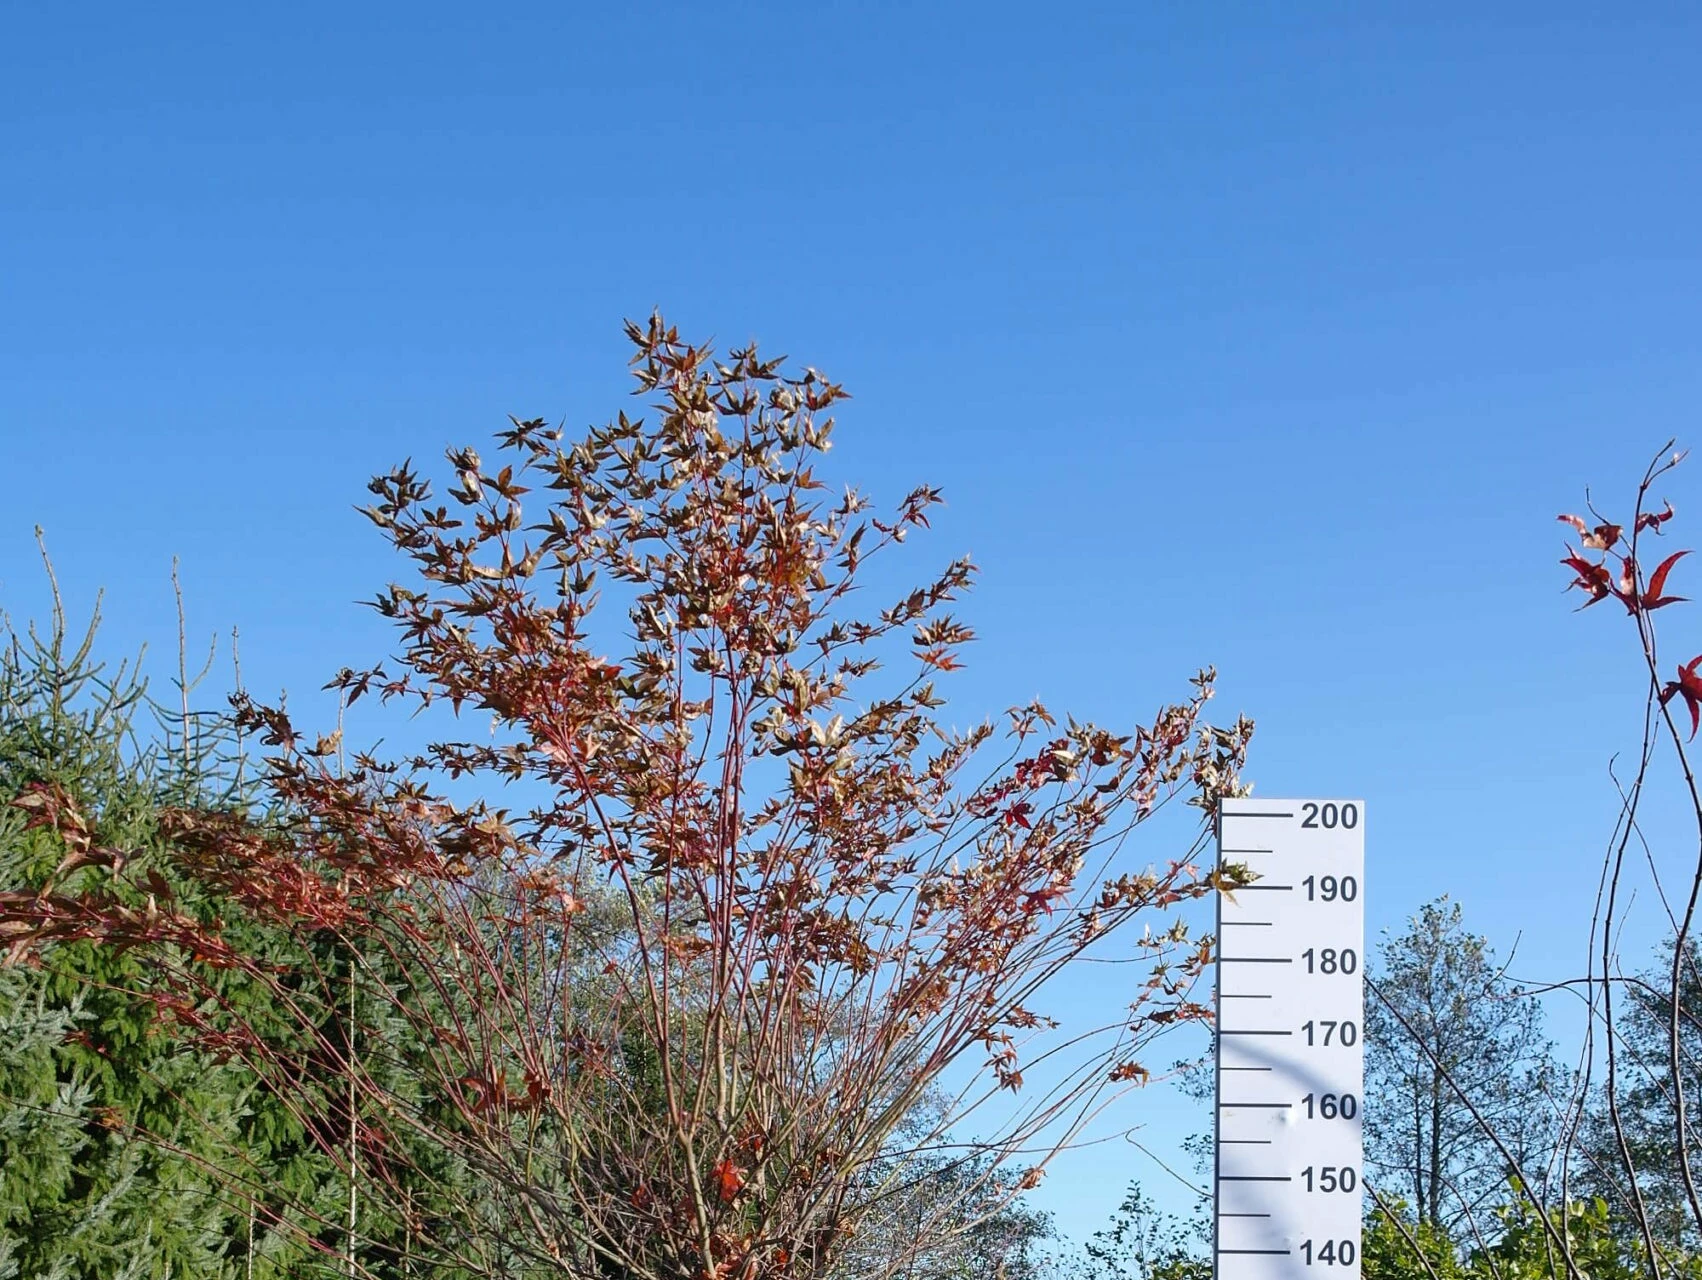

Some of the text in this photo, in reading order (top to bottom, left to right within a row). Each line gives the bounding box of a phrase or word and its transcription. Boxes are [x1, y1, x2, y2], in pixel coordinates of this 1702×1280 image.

[1301, 802, 1358, 829] 200
[1301, 875, 1358, 902] 190
[1301, 948, 1358, 975] 180
[1301, 1020, 1358, 1047] 170
[1301, 1092, 1358, 1121] 160
[1300, 1166, 1357, 1193] 150
[1299, 1239, 1356, 1266] 140
